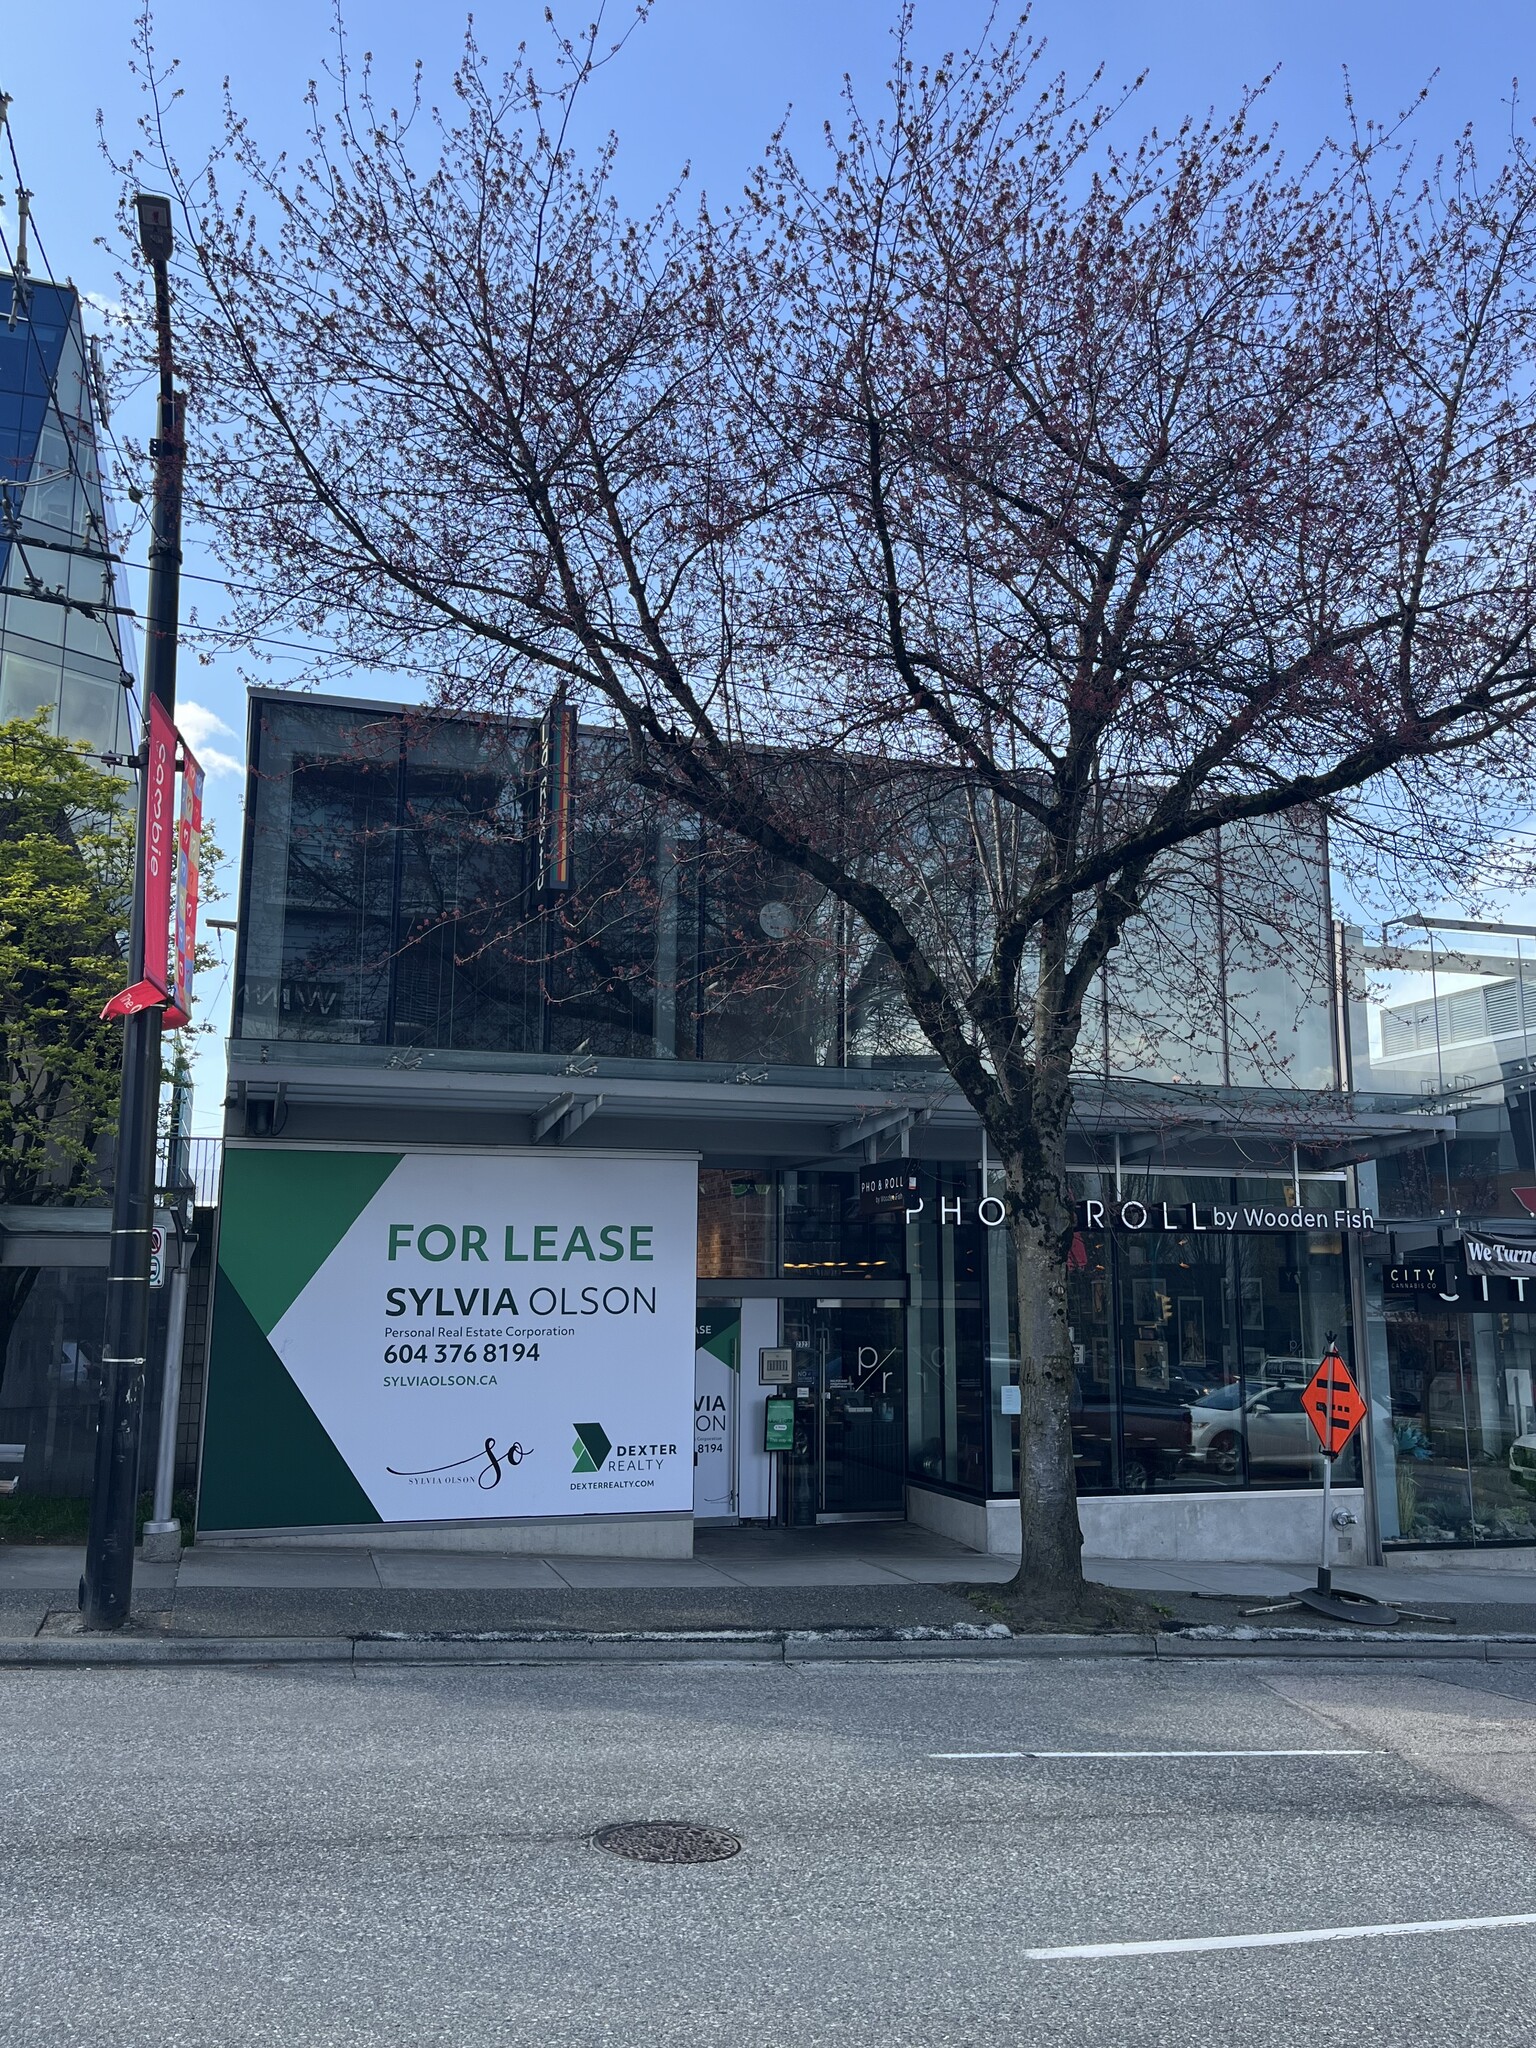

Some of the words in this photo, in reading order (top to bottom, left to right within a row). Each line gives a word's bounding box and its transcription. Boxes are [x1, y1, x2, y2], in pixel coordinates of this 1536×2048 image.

[150, 743, 166, 877] cambie
[120, 993, 134, 1008] The
[861, 1180, 876, 1193] PHO
[877, 1179, 883, 1191] &
[884, 1177, 904, 1189] ROLL
[1086, 1200, 1207, 1231] ROLL
[1213, 1206, 1237, 1230] by
[1243, 1208, 1328, 1228] Wooden
[1334, 1209, 1374, 1230] Fish
[388, 1224, 489, 1262] FOR
[505, 1225, 654, 1262] LEASE
[1467, 1242, 1492, 1262] We
[1390, 1269, 1435, 1281] CITY
[385, 1287, 519, 1317] SYLVIA
[529, 1286, 656, 1316] OLSON
[384, 1327, 435, 1338] Personal
[438, 1326, 463, 1338] Real
[466, 1326, 503, 1337] Estate
[505, 1326, 575, 1339] Corporation
[383, 1344, 428, 1364] 604
[434, 1343, 477, 1363] 376
[483, 1343, 540, 1363] 8194
[383, 1375, 498, 1387] SYLVIAOLSON.CA
[696, 1415, 726, 1432] ON
[616, 1444, 677, 1457] DEXTER
[697, 1444, 723, 1454] 8194
[608, 1459, 664, 1472] REALTY
[408, 1477, 442, 1485] SYLVIA
[445, 1476, 476, 1484] OLSON
[570, 1480, 655, 1491] DEXTERREALTY.COM
